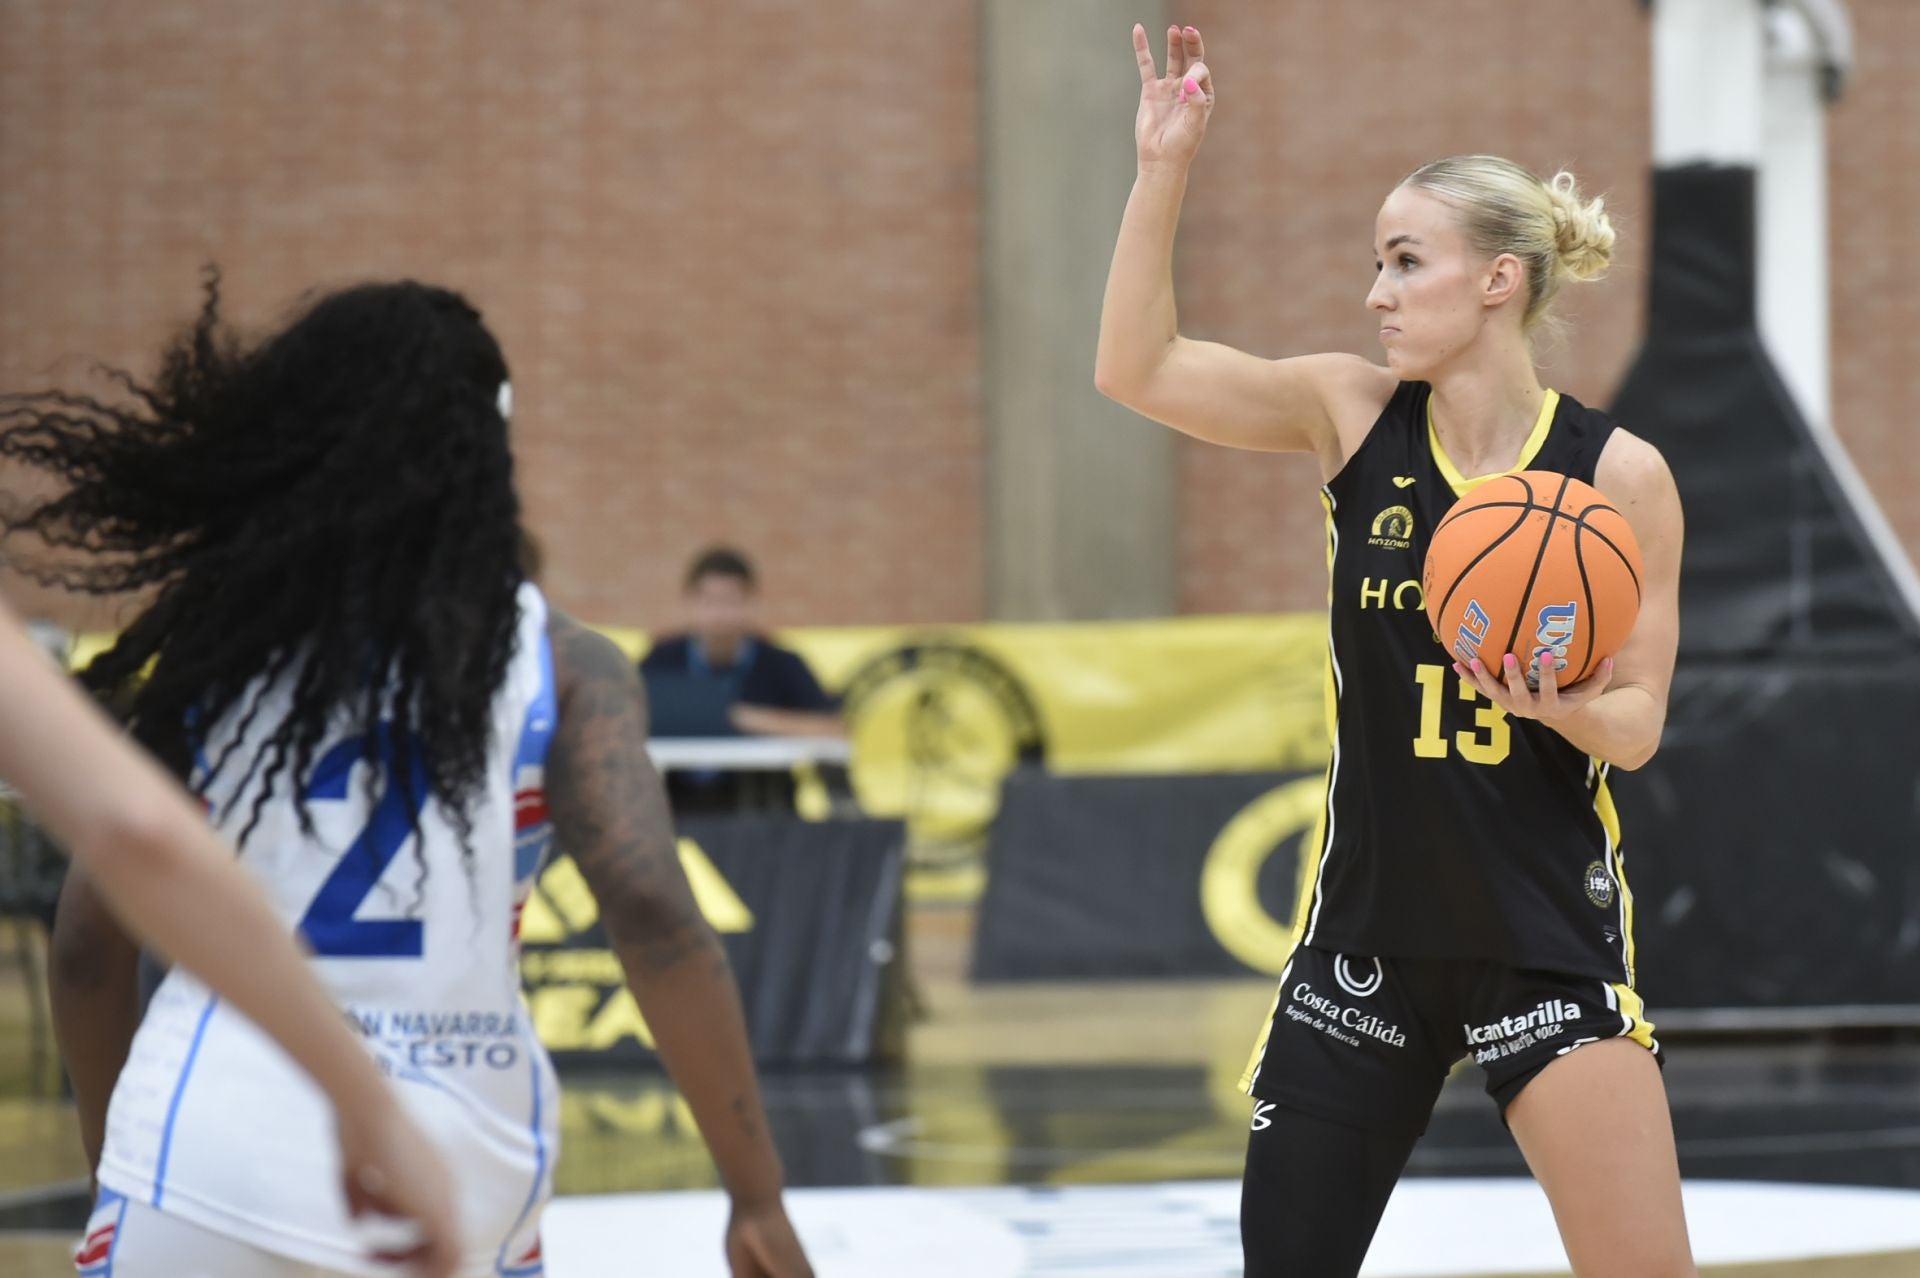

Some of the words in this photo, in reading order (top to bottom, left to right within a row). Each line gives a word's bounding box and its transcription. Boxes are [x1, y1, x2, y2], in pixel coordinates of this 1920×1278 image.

[1413, 663, 1511, 766] 13
[297, 722, 431, 957] 2
[390, 1010, 517, 1038] NAVARRA
[1284, 1003, 1313, 1026] Región
[1312, 1017, 1326, 1032] de
[1325, 1024, 1360, 1048] Murcia
[1292, 982, 1341, 1021] Costa
[1341, 1007, 1407, 1048] Cálida
